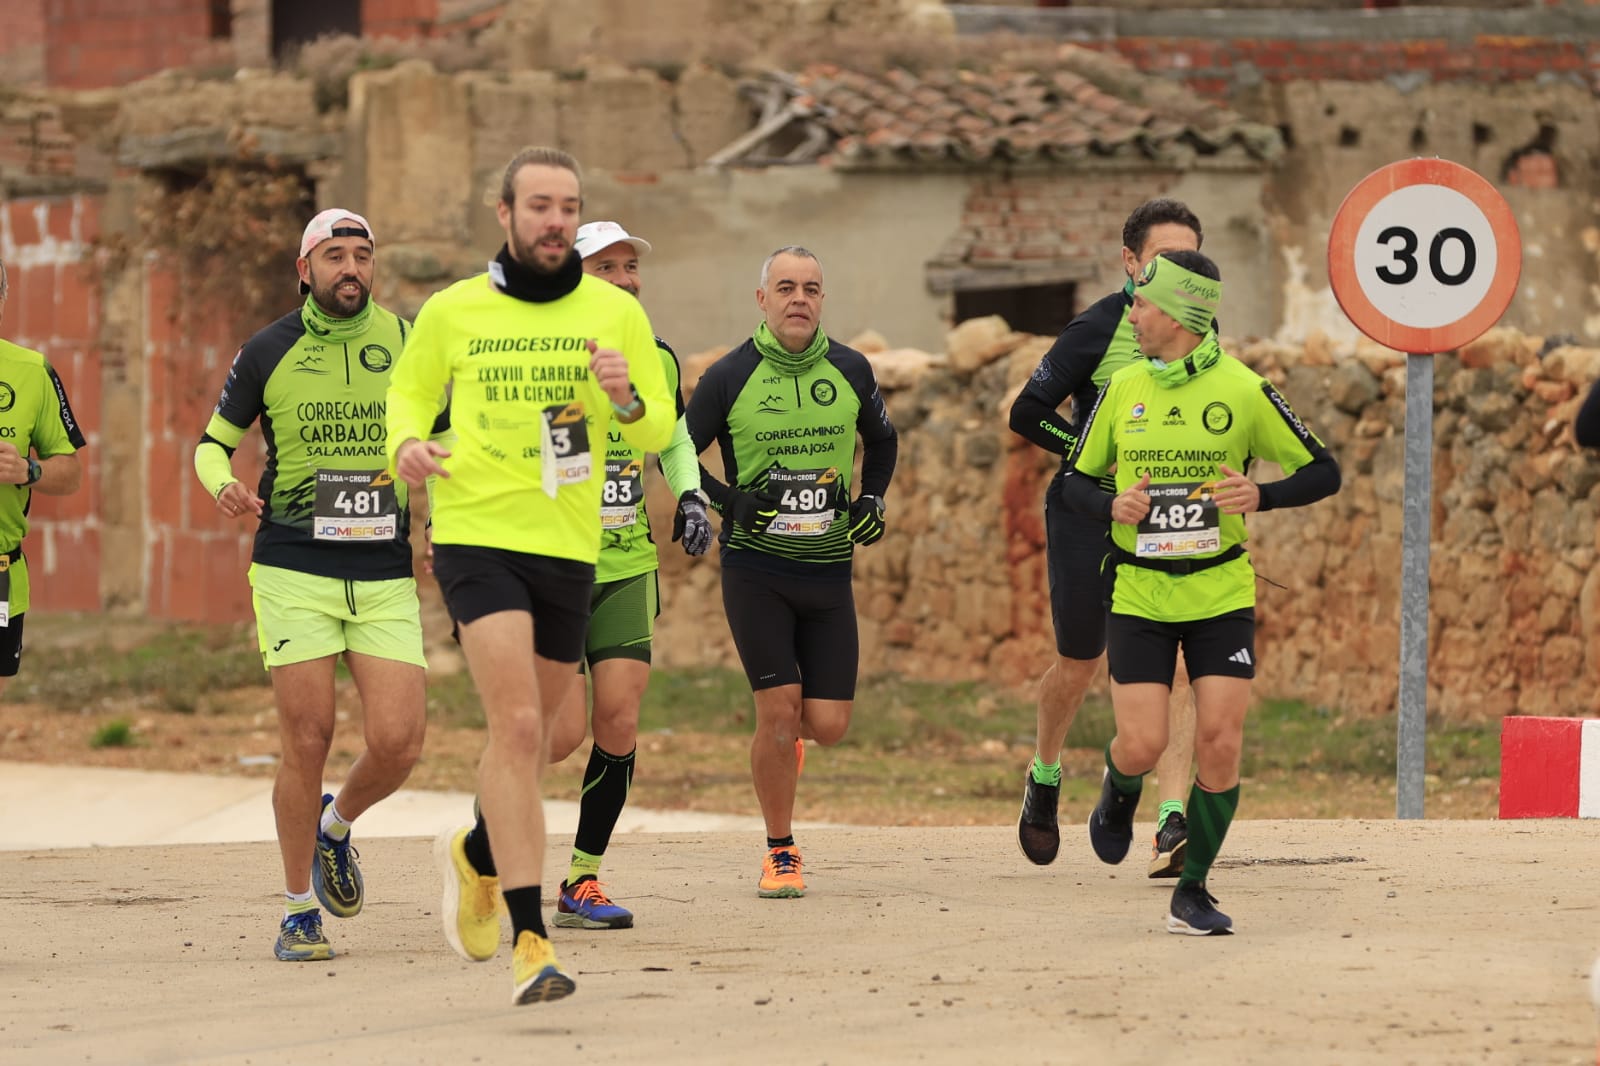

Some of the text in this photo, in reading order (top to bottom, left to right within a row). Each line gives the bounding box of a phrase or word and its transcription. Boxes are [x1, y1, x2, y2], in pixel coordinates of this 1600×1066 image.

[1375, 226, 1477, 286] 30
[468, 337, 598, 356] BRIDGESTON
[478, 365, 589, 382] XXXVIII CARRERA
[486, 385, 575, 401] DE LA CIENCIA
[755, 425, 845, 442] CORRECAMINOS
[767, 442, 835, 456] CARBAJOSA
[1124, 449, 1228, 463] CORRECAMINOS
[328, 474, 344, 483] LIGA
[349, 475, 371, 483] CROSS
[797, 473, 817, 481] CROSS
[1135, 465, 1216, 479] CARBAJOSA
[603, 480, 632, 503] 83
[780, 488, 828, 511] 490
[1165, 488, 1188, 496] CROSS
[334, 490, 380, 514] 481
[1149, 503, 1205, 529] 482
[317, 525, 394, 537] JOMISAGA
[769, 520, 832, 532] JOMISAGA
[1139, 538, 1218, 554] JOMISAGA
